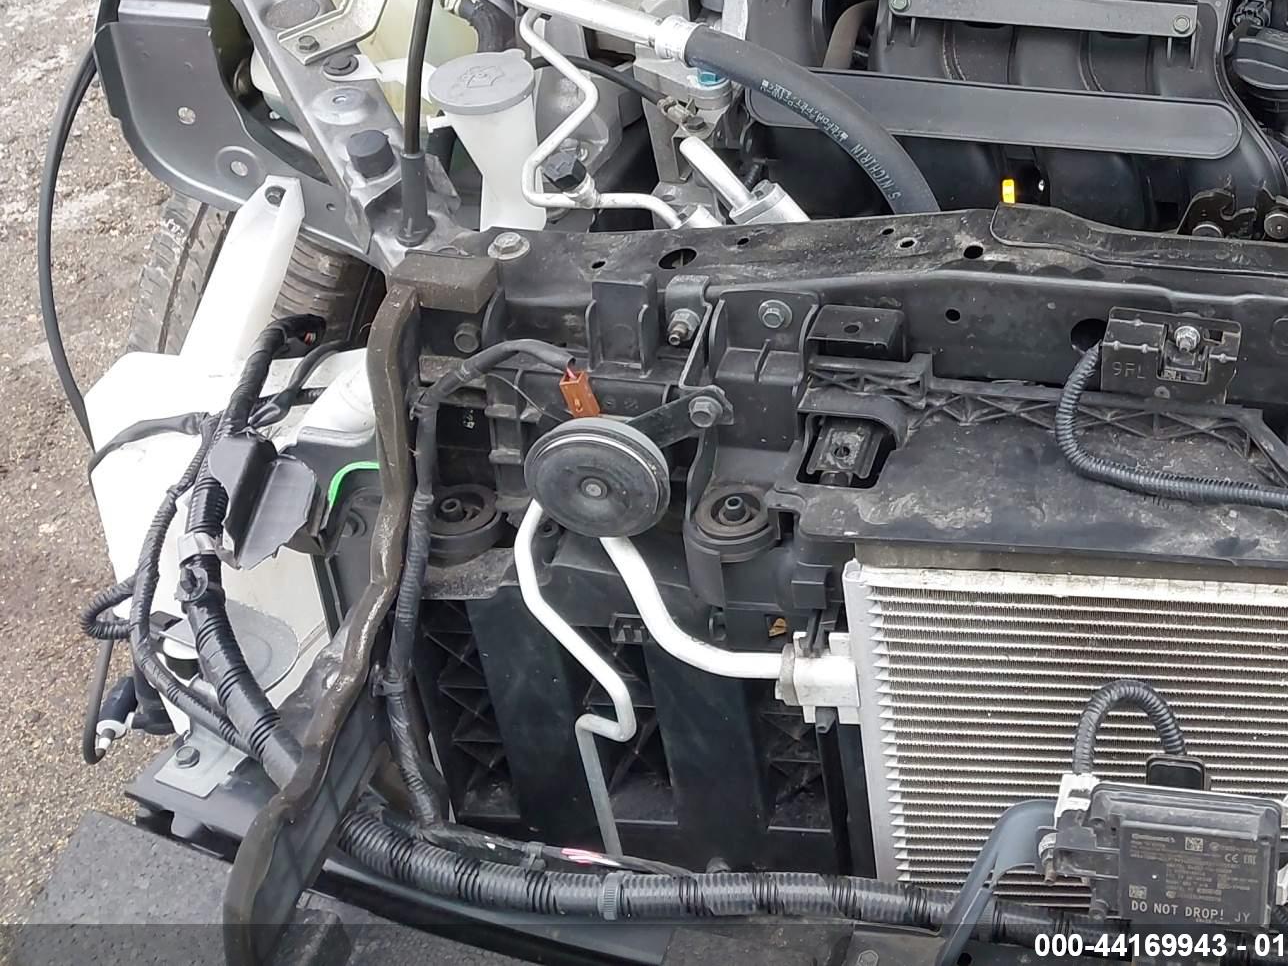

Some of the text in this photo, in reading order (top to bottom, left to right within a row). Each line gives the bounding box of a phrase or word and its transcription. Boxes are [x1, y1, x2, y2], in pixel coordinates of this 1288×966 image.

[850, 143, 896, 190] NICHIRIN
[1131, 900, 1148, 912] DO
[1153, 903, 1179, 915] NOT
[1185, 906, 1225, 921] DROP!
